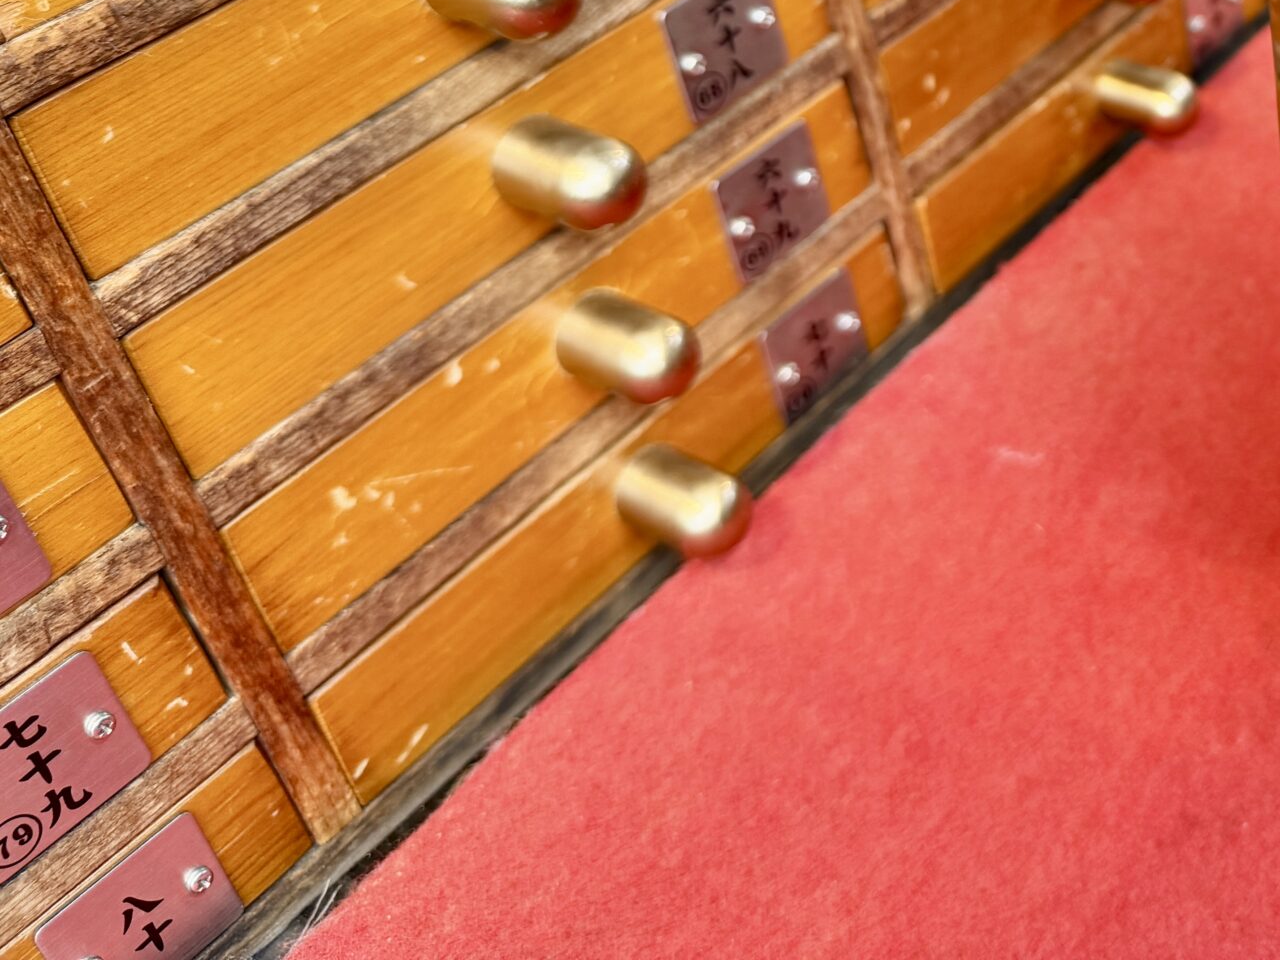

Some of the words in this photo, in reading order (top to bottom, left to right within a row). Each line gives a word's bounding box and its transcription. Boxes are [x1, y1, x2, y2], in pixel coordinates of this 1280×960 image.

[0, 714, 94, 830] 七十九
[122, 896, 174, 952] 八十
